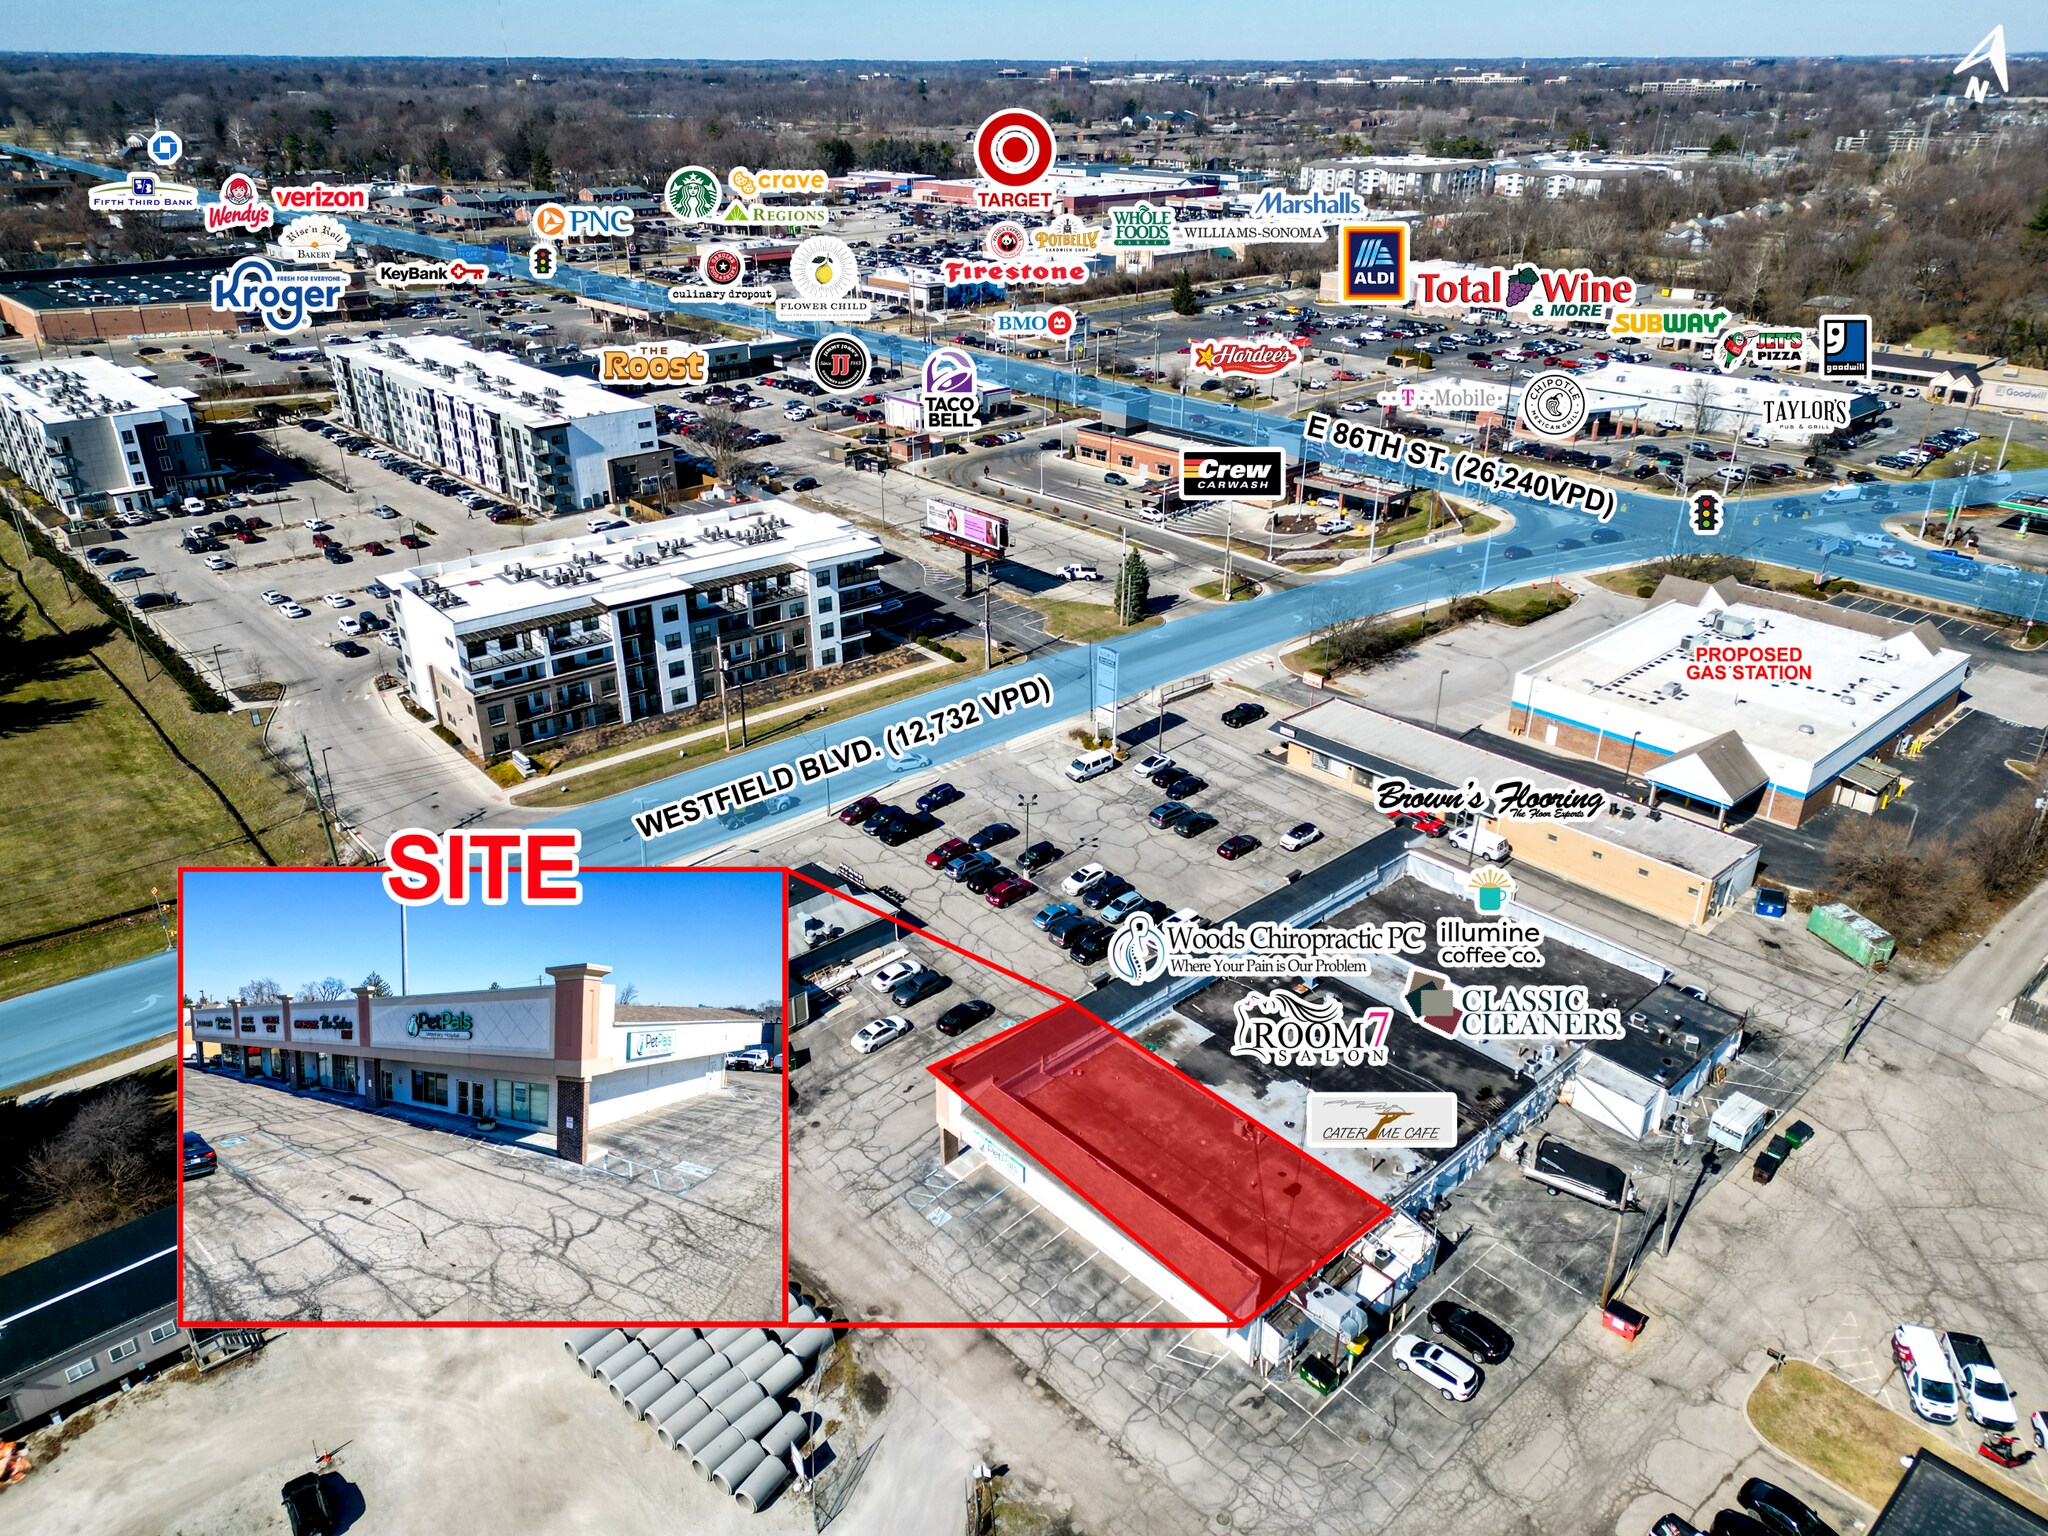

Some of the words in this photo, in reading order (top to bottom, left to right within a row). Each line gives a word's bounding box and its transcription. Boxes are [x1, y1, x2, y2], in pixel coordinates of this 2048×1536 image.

[2006, 388, 2047, 400] Goodwill
[418, 1012, 473, 1030] PetPals
[646, 1033, 672, 1048] PetPals
